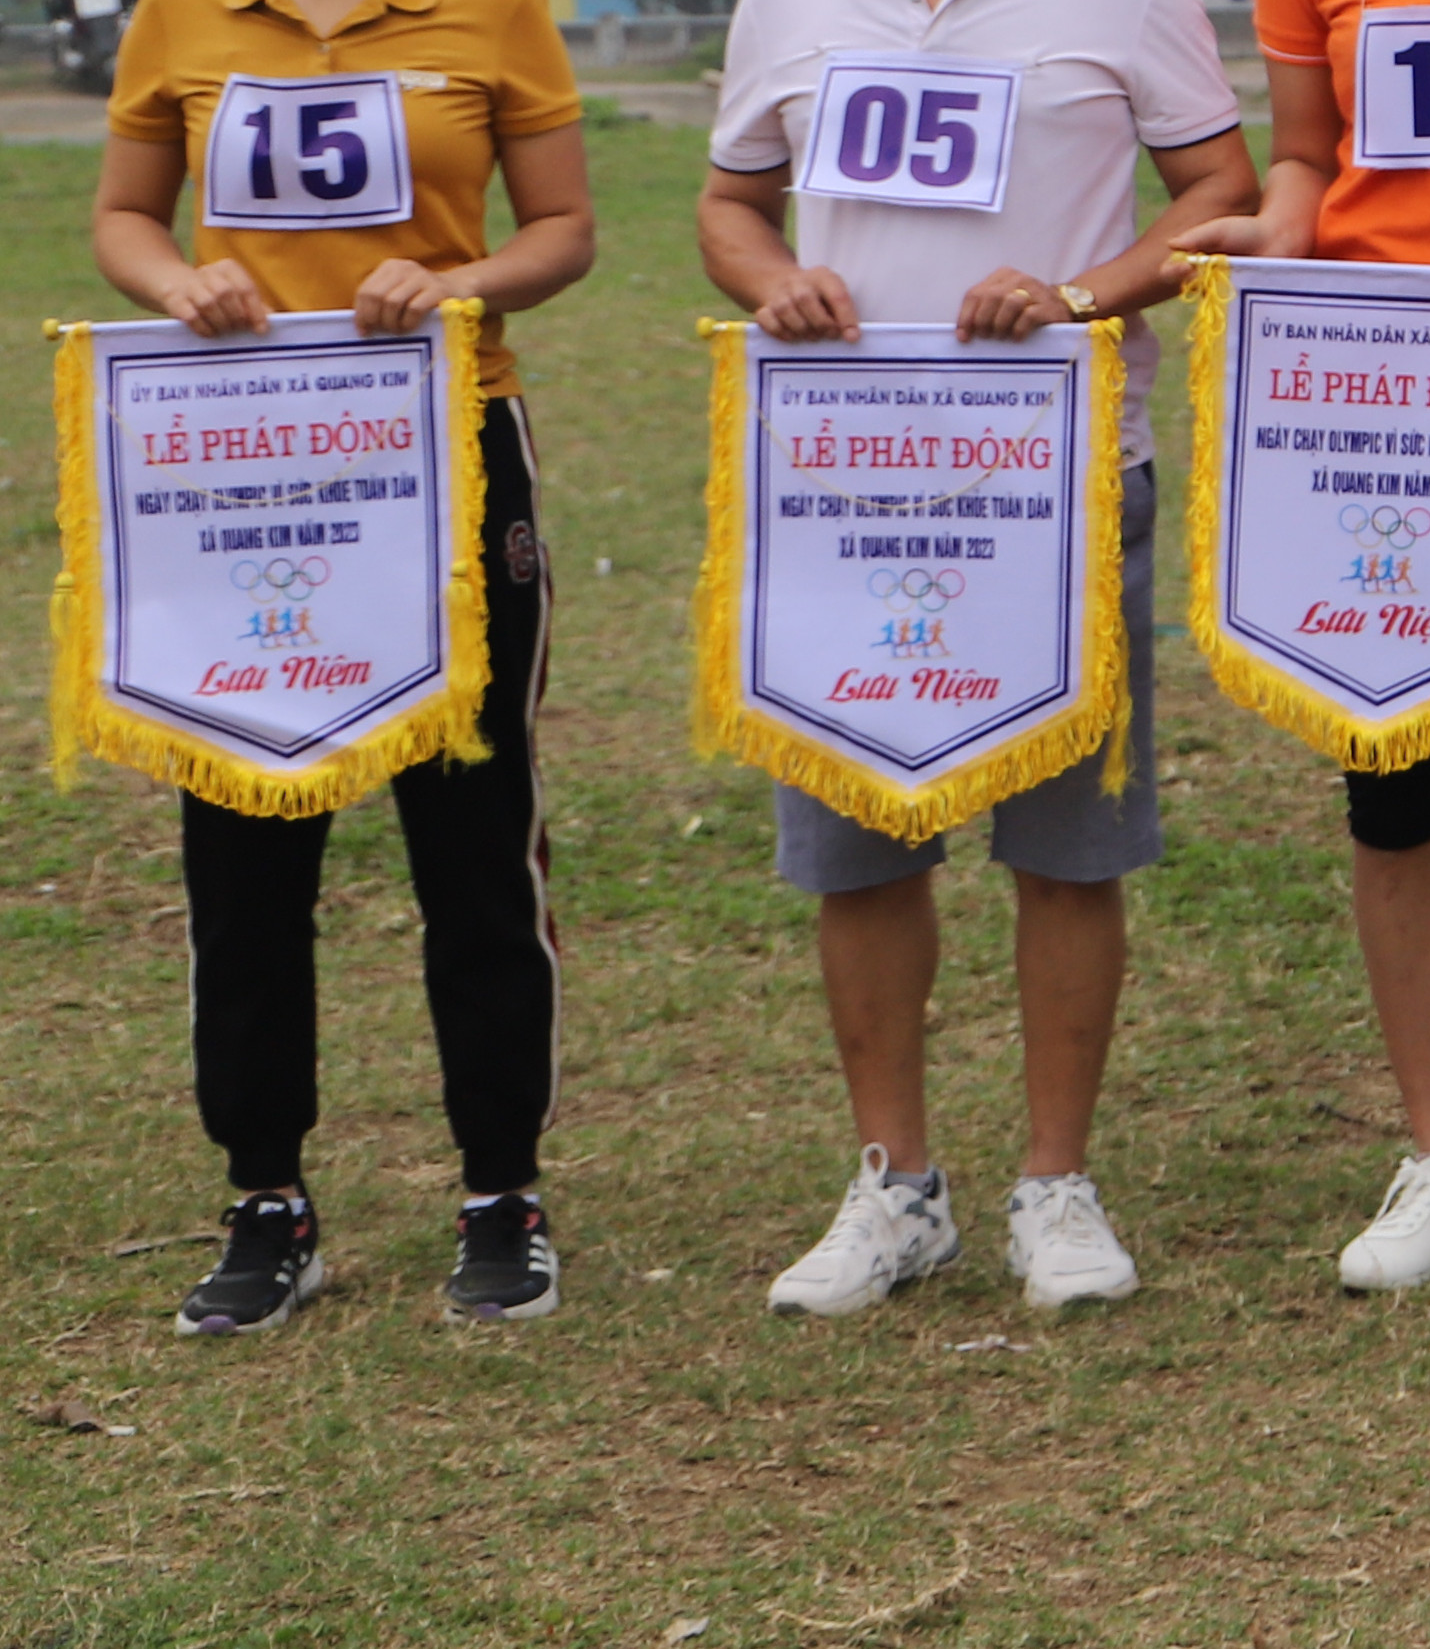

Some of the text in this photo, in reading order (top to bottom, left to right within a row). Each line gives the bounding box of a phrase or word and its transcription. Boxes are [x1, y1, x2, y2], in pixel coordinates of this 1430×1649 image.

[244, 102, 368, 200] 15
[838, 86, 979, 186] 05
[1269, 353, 1312, 401] LỄ
[1322, 364, 1415, 406] PHÁT
[144, 411, 413, 465] LỄ PHÁT ĐỘNG
[791, 419, 1052, 478] LỄ PHÁT ĐỘNG
